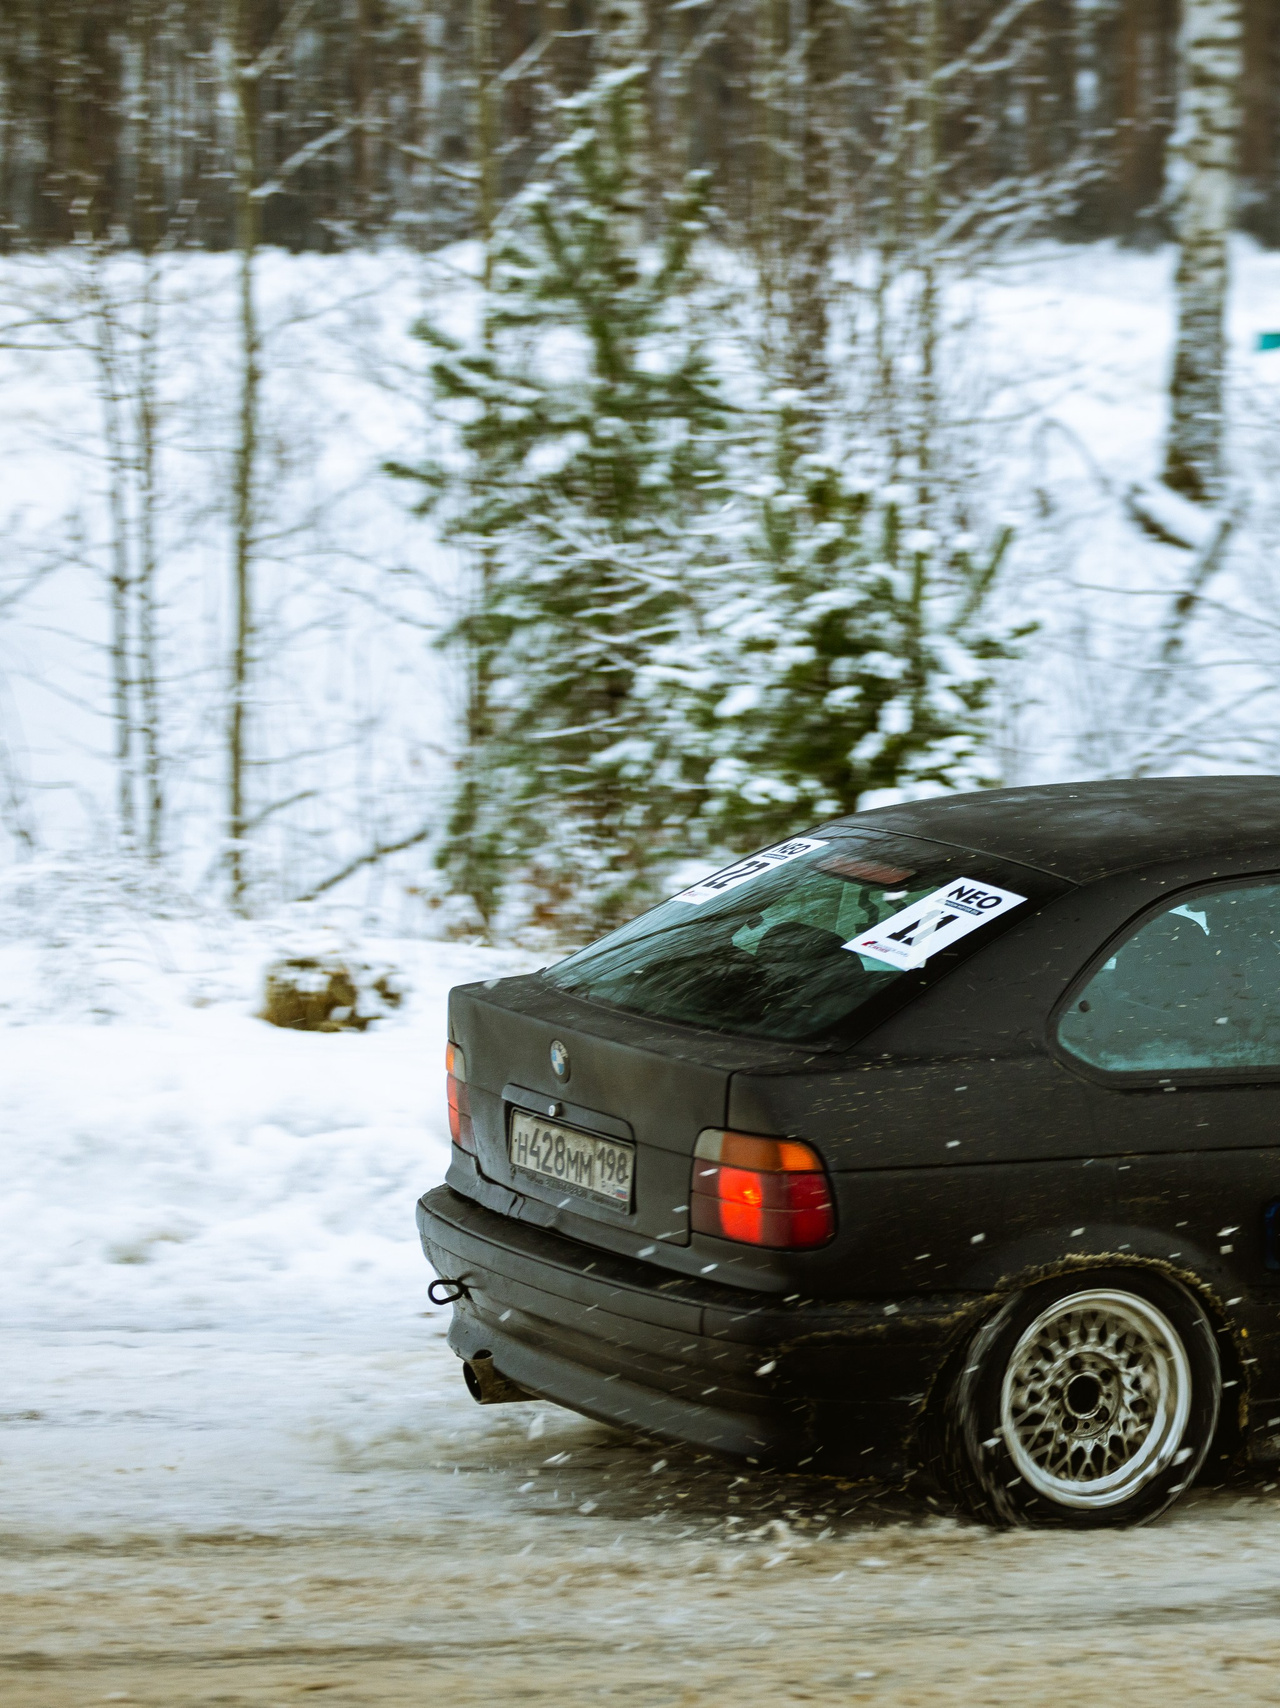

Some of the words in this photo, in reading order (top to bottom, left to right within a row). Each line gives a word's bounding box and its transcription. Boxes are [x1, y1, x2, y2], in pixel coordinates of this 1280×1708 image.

[702, 860, 770, 889] 22
[947, 885, 1003, 909] NEO
[517, 1128, 593, 1187] Н428ММ
[597, 1147, 628, 1184] 198
